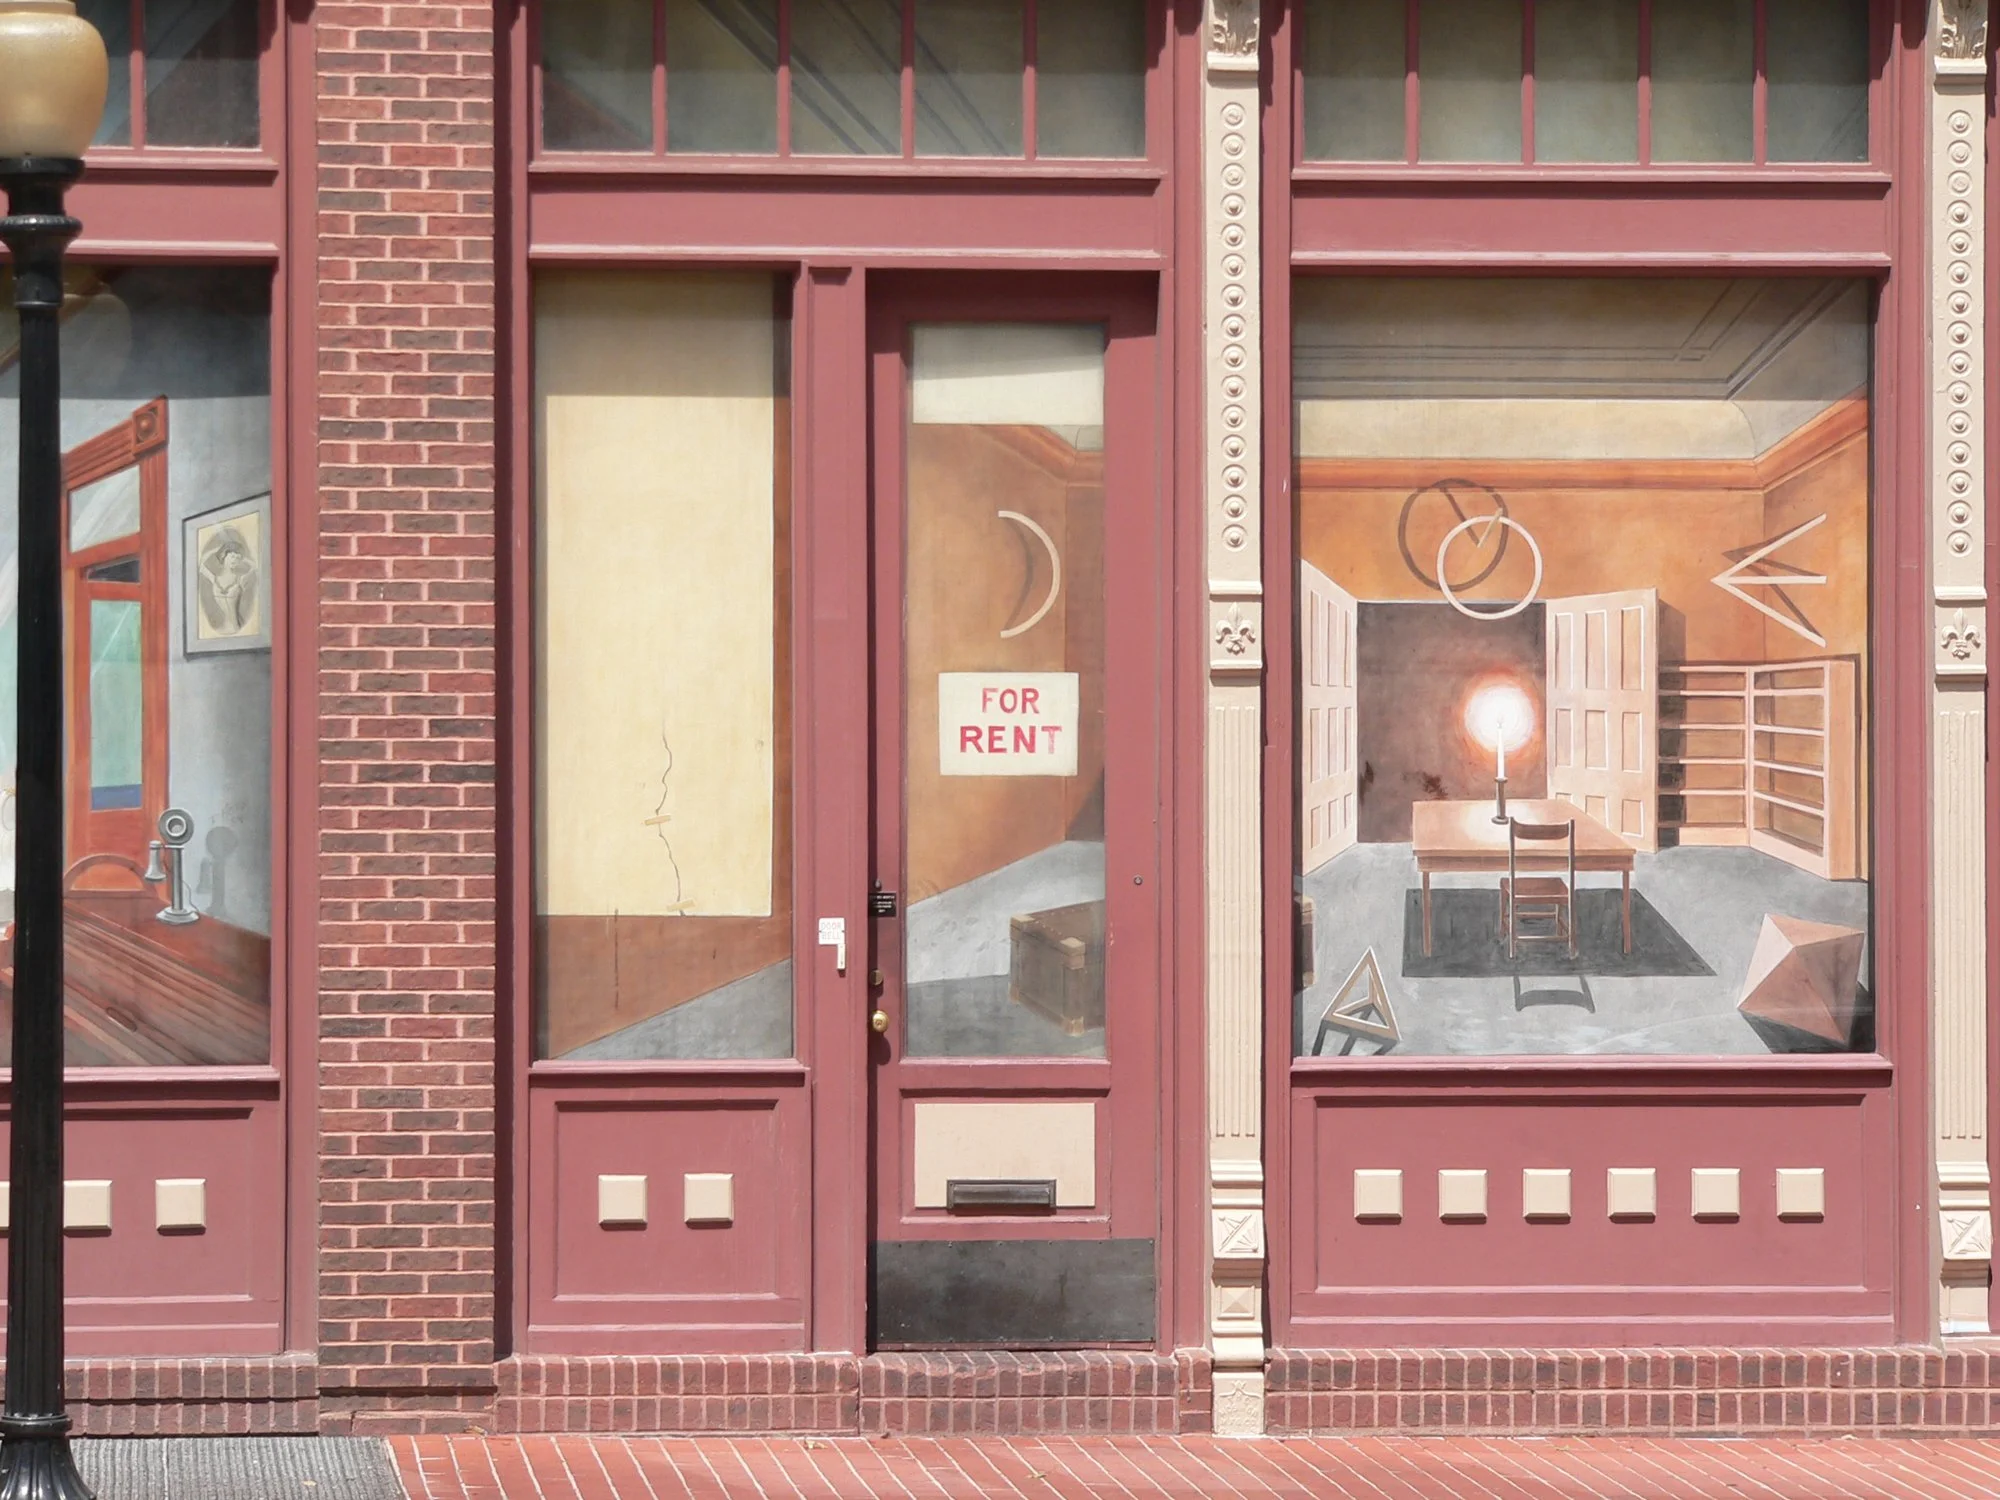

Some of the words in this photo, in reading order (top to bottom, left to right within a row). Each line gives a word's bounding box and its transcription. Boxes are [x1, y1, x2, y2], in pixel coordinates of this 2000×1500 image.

[982, 687, 1040, 714] FOR
[960, 725, 1062, 754] RENT
[821, 922, 842, 931] DOOR
[821, 931, 841, 940] BELL
